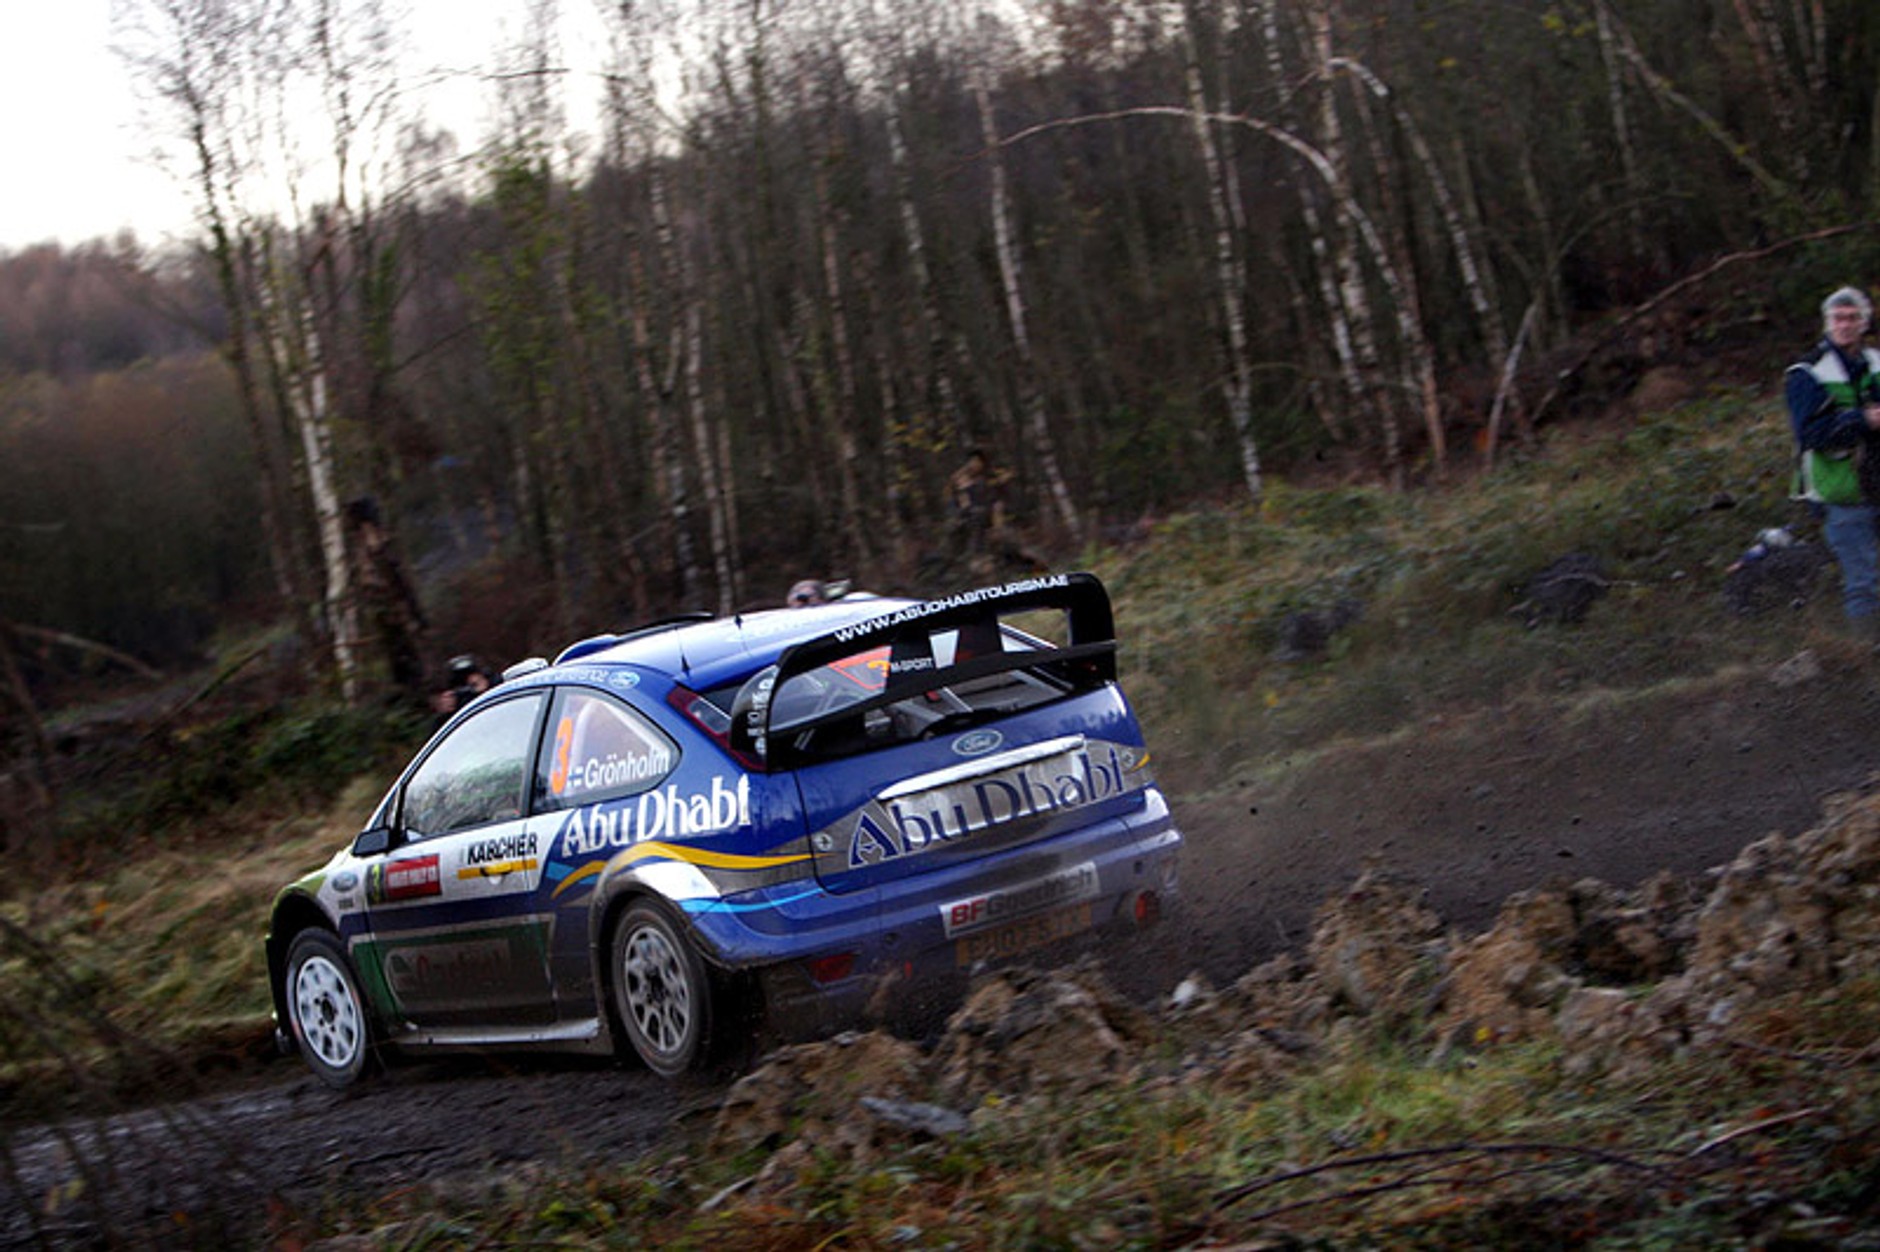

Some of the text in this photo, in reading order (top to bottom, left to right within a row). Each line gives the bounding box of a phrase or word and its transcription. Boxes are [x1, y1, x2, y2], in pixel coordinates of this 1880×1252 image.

[834, 573, 1070, 643] WWW.ABUDHABITOURISM.AE
[552, 717, 573, 794] 3
[585, 743, 671, 788] Grönholm
[562, 773, 752, 858] Abu Dhabi
[849, 746, 1124, 868] Abu Dhabi
